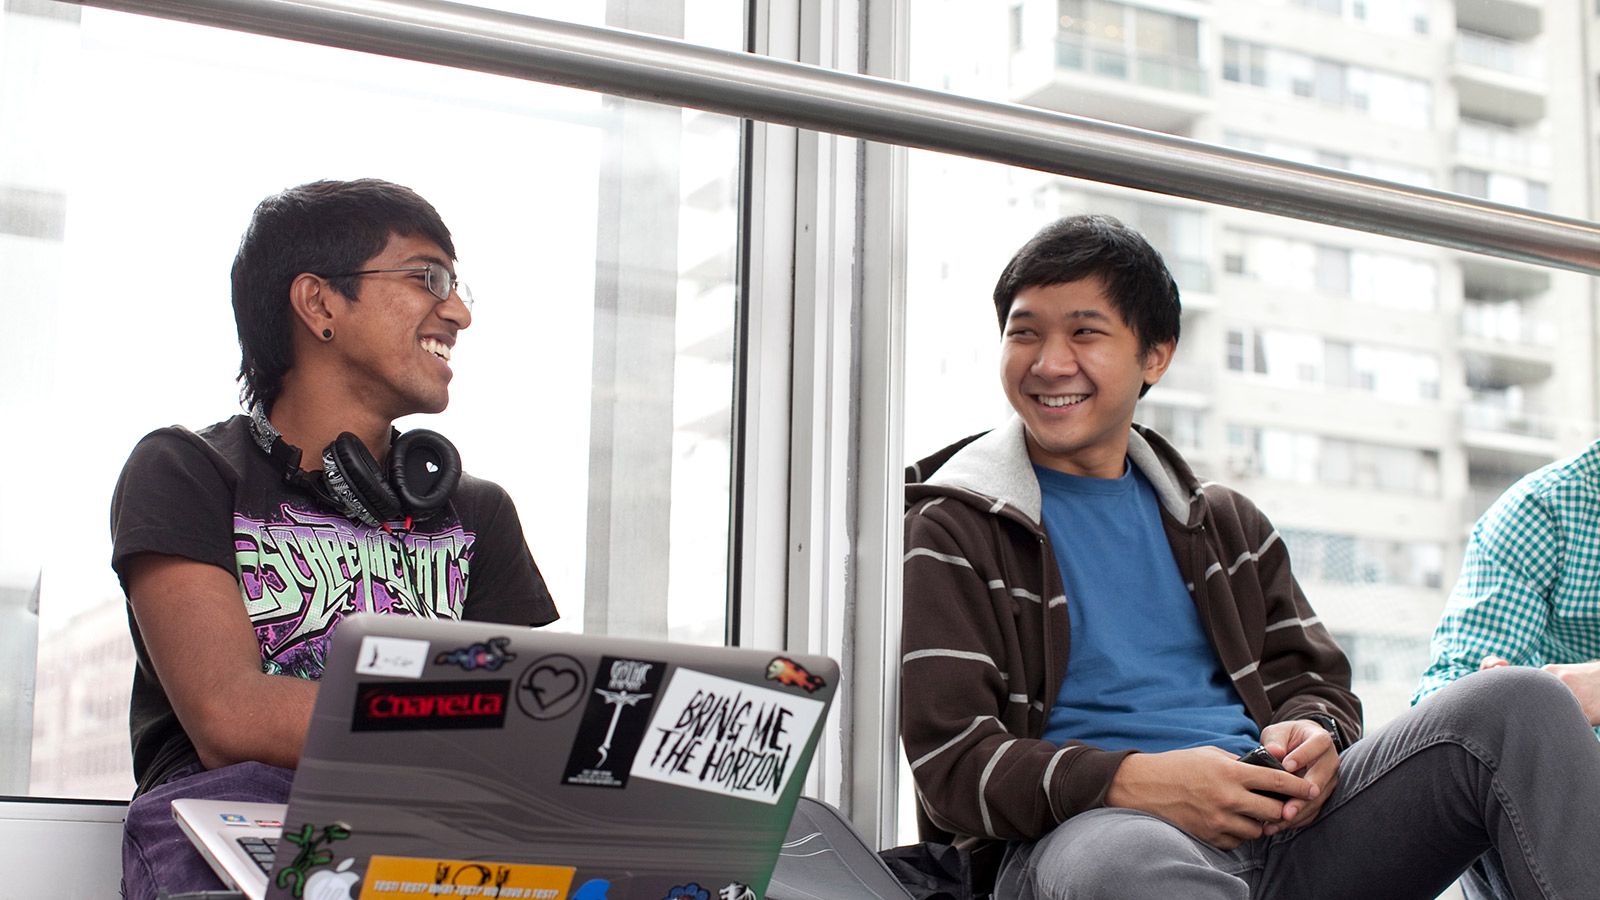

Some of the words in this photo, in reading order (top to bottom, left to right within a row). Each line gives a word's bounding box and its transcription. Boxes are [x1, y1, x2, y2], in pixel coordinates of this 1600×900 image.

[674, 689, 750, 748] BRING
[748, 701, 794, 751] ME
[650, 726, 703, 776] THE
[699, 742, 791, 797] HORIZON
